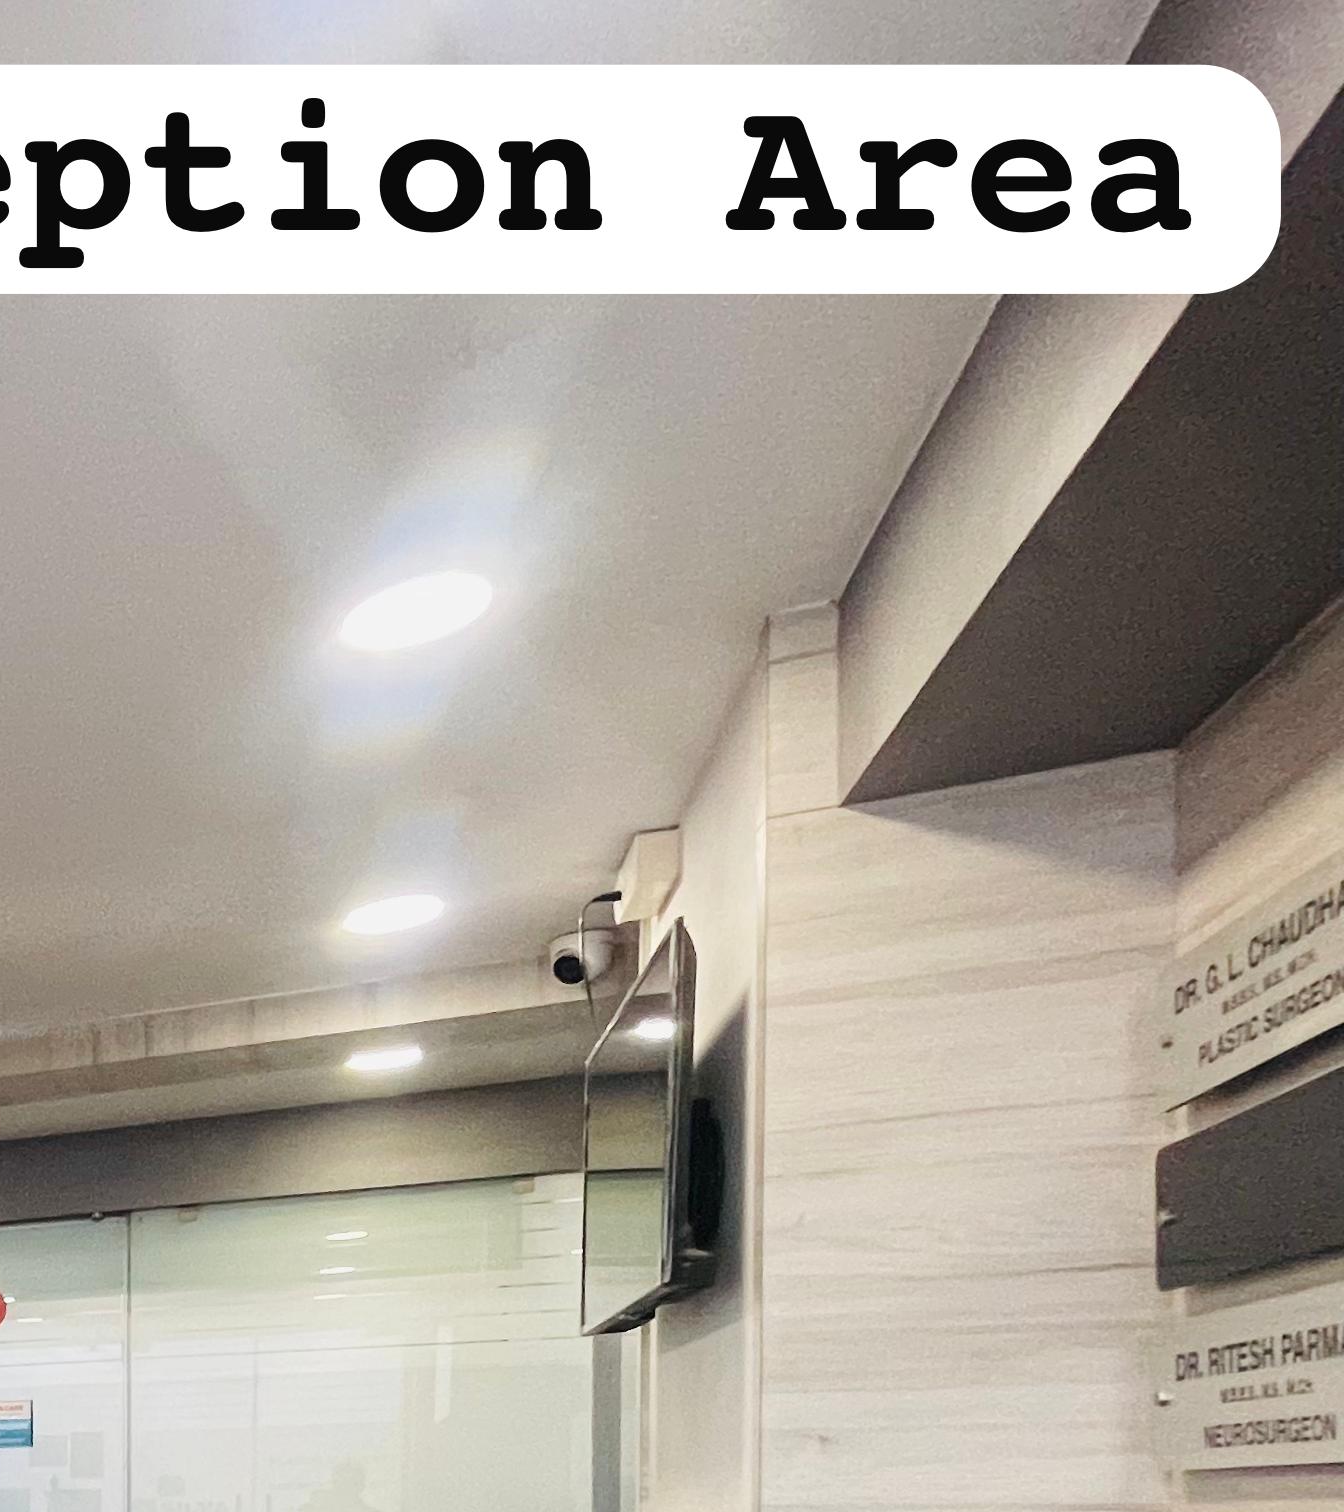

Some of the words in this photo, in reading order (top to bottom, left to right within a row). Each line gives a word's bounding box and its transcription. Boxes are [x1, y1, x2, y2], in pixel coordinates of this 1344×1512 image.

[1198, 1014, 1259, 1067] PLASTIC
[1175, 1352, 1203, 1381] DR.
[1208, 1336, 1275, 1376] RITESH
[1281, 1323, 1344, 1365] PARM
[1204, 1414, 1336, 1448] NEUROSURGEON
